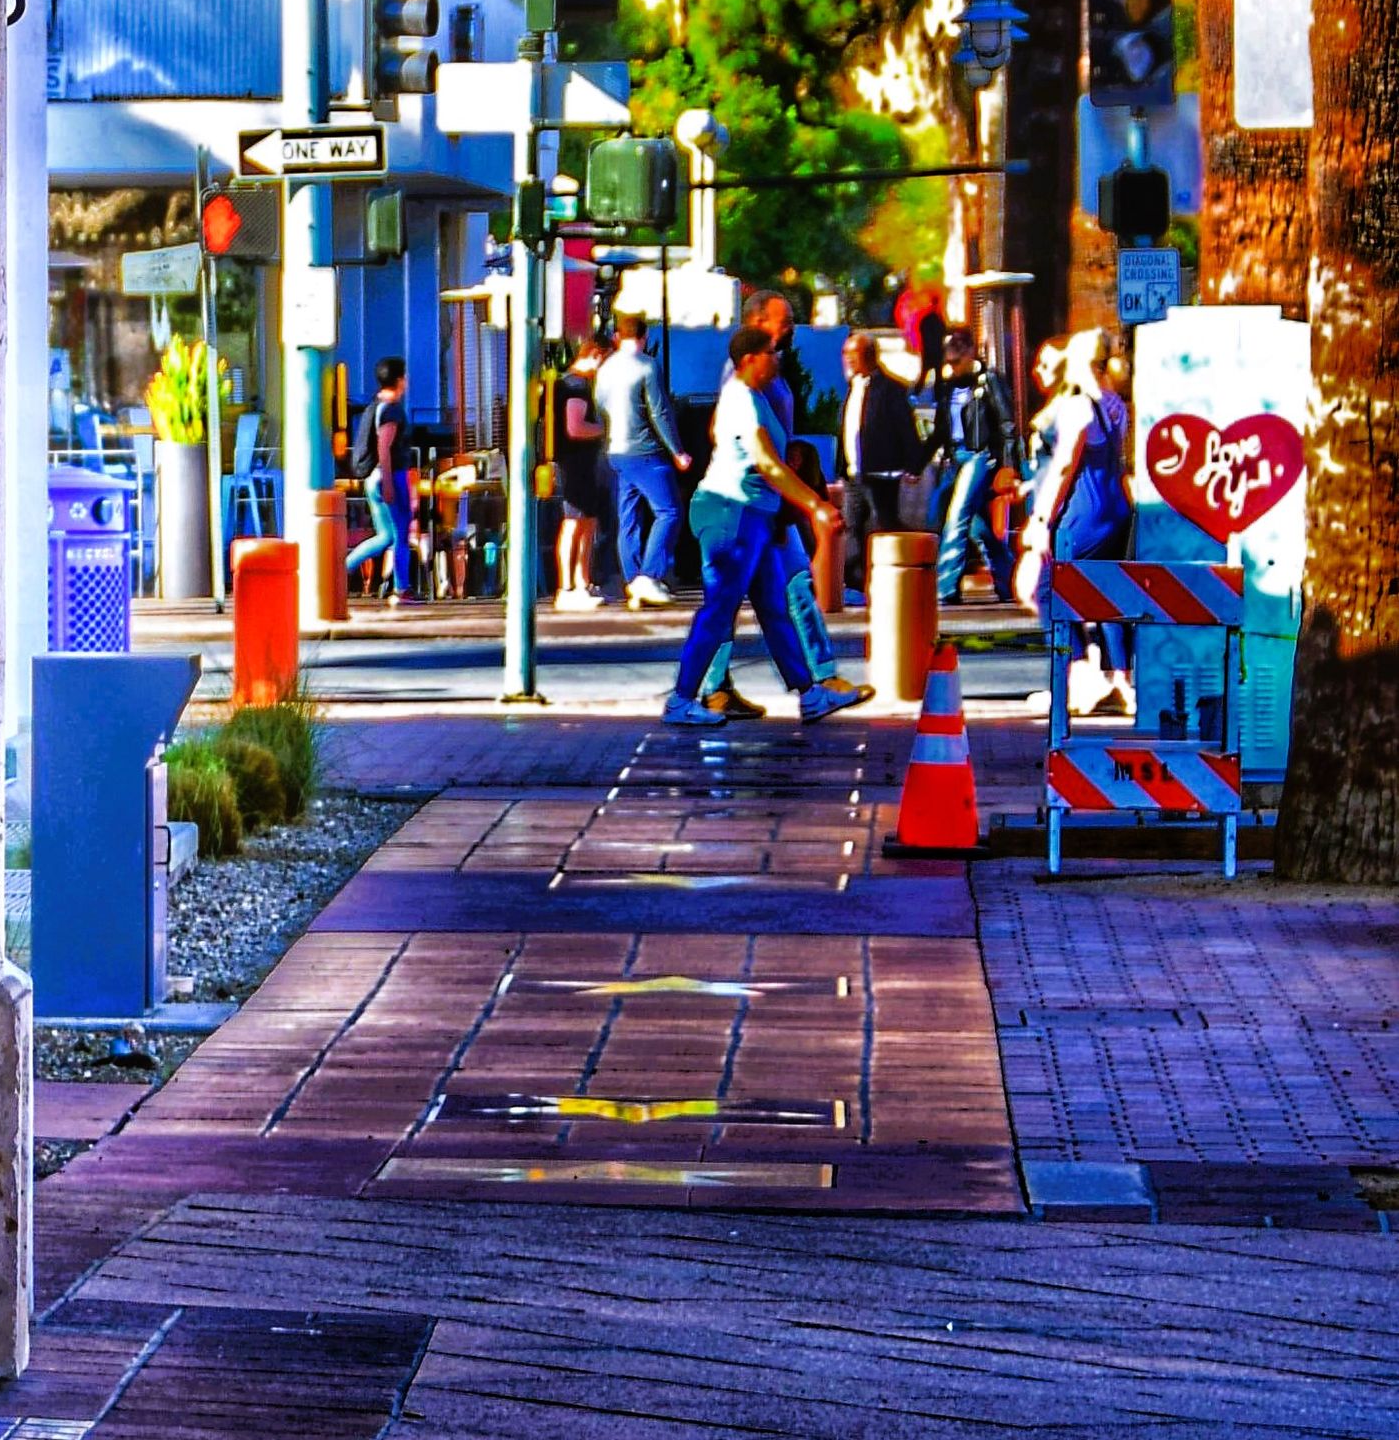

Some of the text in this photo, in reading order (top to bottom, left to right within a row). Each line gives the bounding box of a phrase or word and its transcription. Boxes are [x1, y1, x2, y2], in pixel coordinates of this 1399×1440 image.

[282, 139, 369, 160] ONE WAY
[1124, 253, 1171, 266] DIAGONAL
[1124, 268, 1175, 280] CROSSING
[1124, 293, 1143, 311] OK
[1194, 430, 1262, 486] Love
